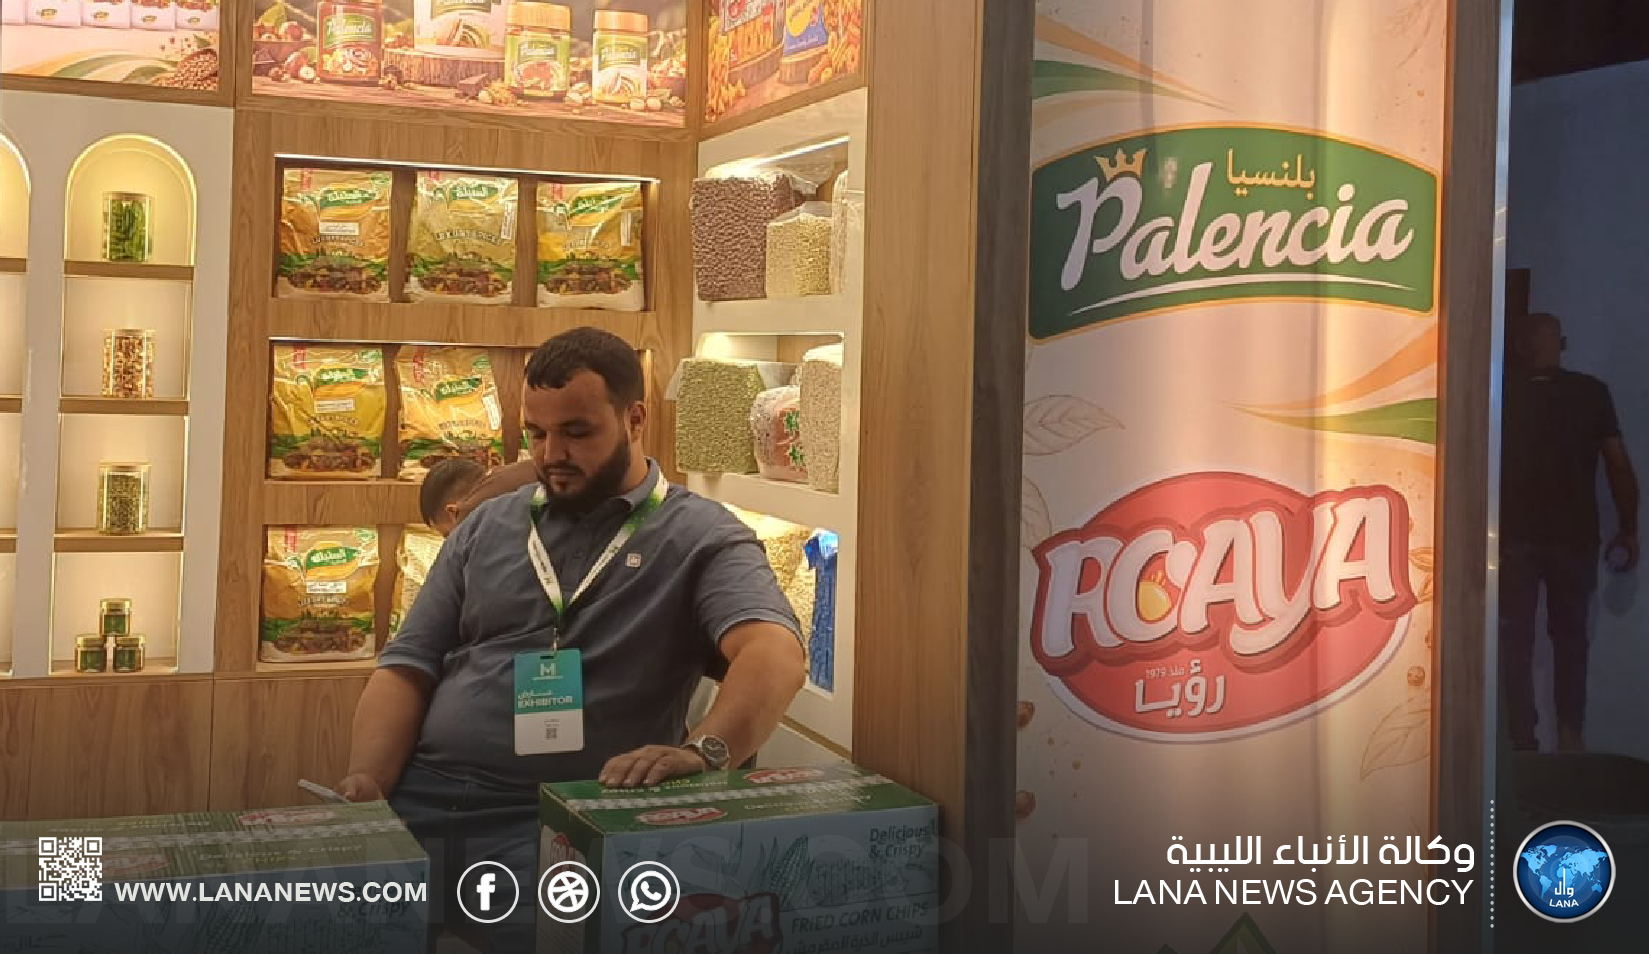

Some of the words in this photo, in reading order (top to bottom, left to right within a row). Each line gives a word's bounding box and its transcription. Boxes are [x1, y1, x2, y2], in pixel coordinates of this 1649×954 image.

[1227, 147, 1316, 201] بلنسيا
[1055, 160, 1415, 292] Palencia
[1134, 658, 1226, 718] رؤيا
[791, 914, 835, 935] FRIED
[838, 908, 882, 928] CORN
[886, 901, 929, 922] CHIPS
